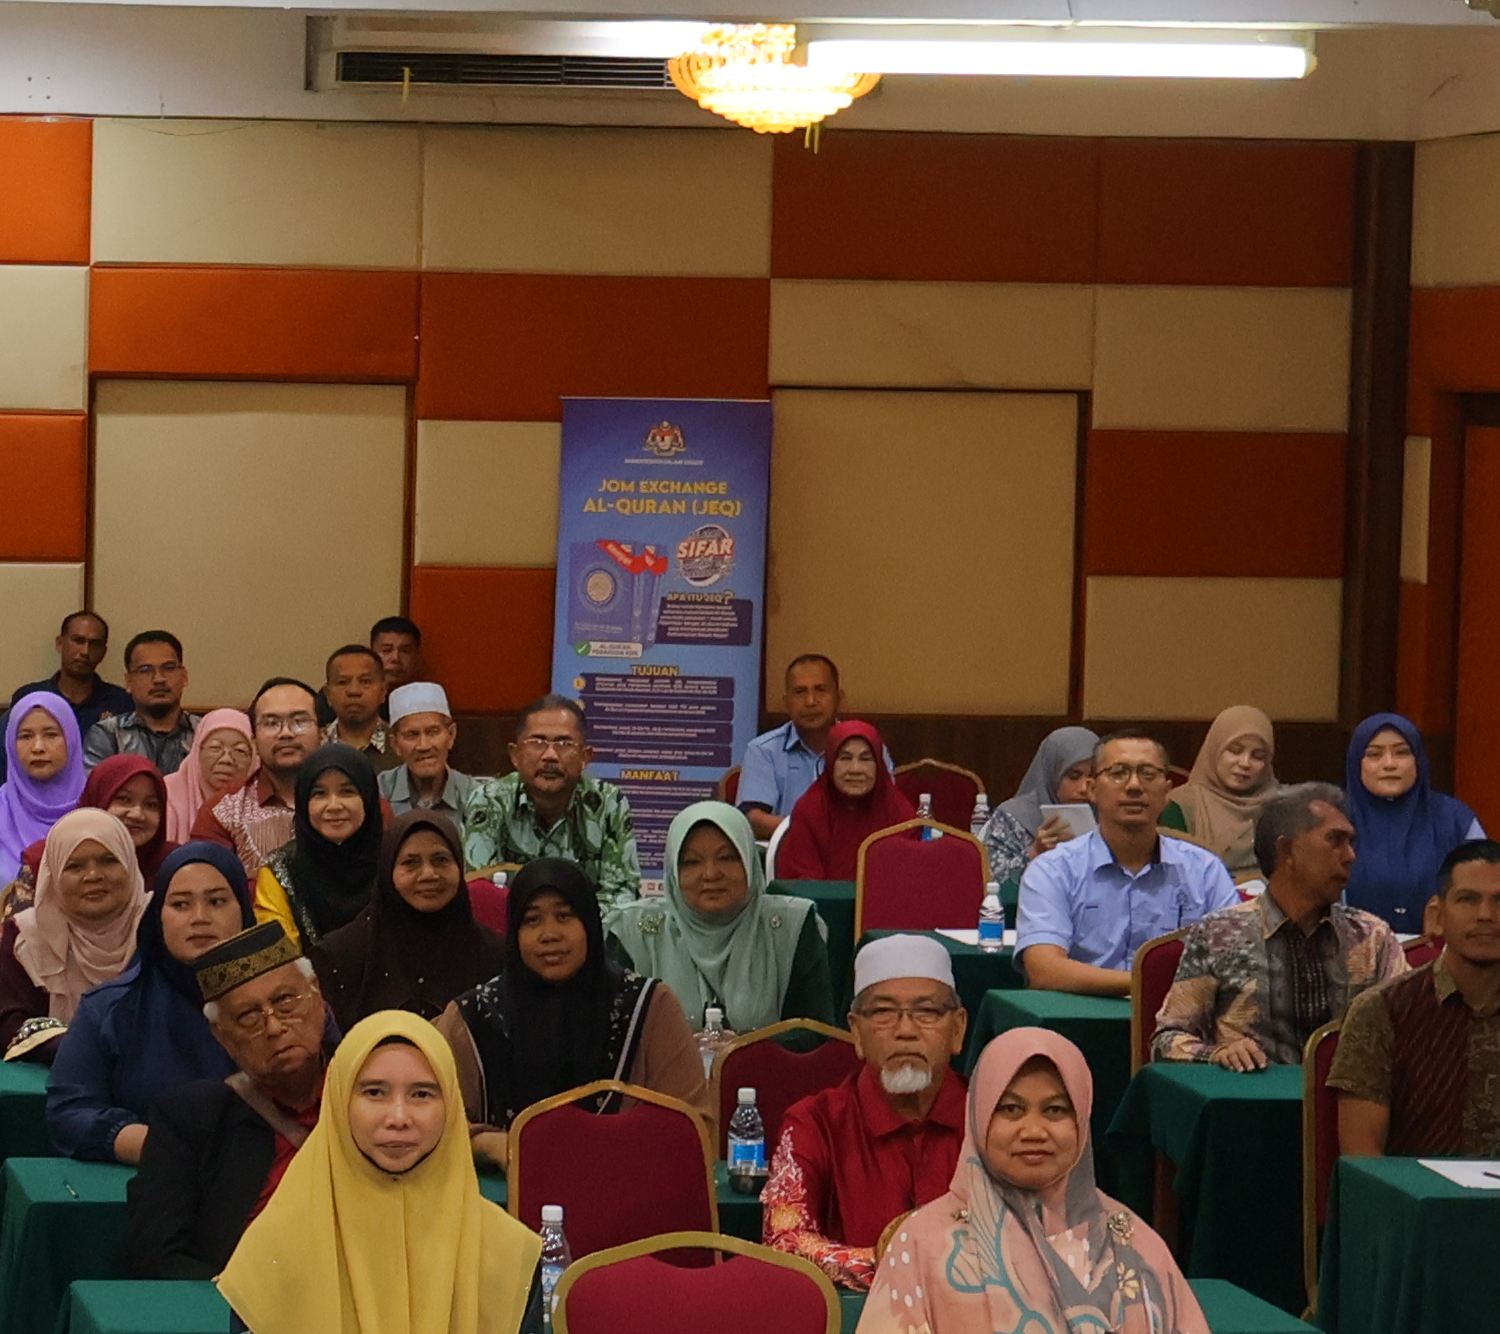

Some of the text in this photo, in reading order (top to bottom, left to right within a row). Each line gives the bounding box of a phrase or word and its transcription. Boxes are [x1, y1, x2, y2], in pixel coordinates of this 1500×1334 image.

[598, 479, 728, 495] JOM EXCHANGE
[583, 497, 742, 518] AL-QURAN (JEQ)
[677, 538, 734, 559] SIFAR
[631, 666, 680, 677] TUJUAN
[620, 770, 679, 781] MANFAAT
